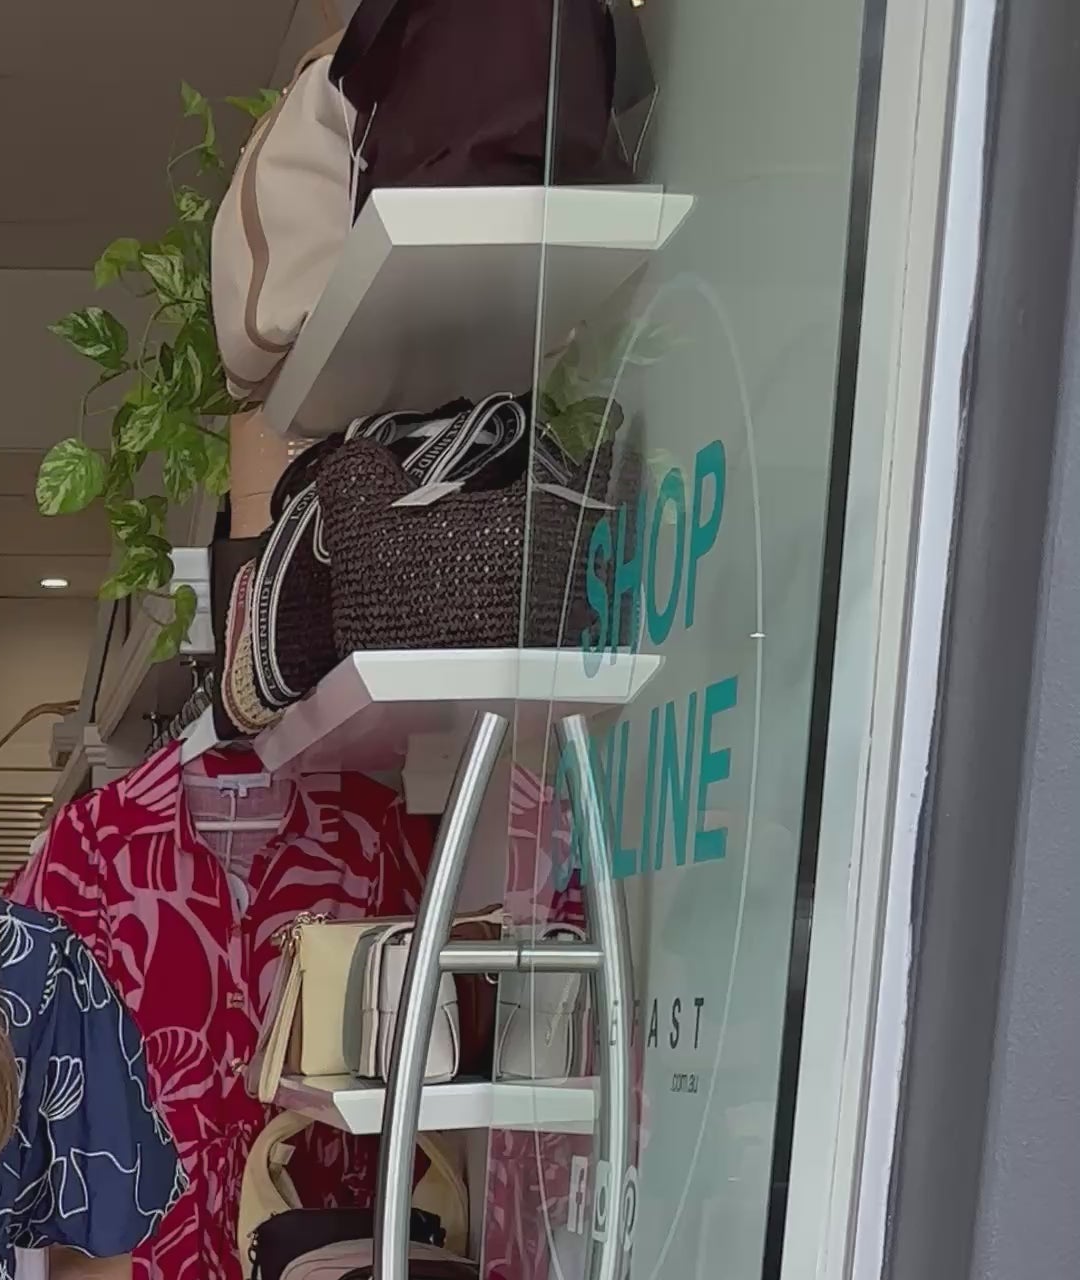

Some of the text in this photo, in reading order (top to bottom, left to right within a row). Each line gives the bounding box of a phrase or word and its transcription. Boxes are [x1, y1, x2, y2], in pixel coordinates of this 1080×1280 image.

[259, 575, 276, 690] LOUENHIDE
[581, 439, 726, 679] SHOP
[553, 675, 738, 892] ONLINE
